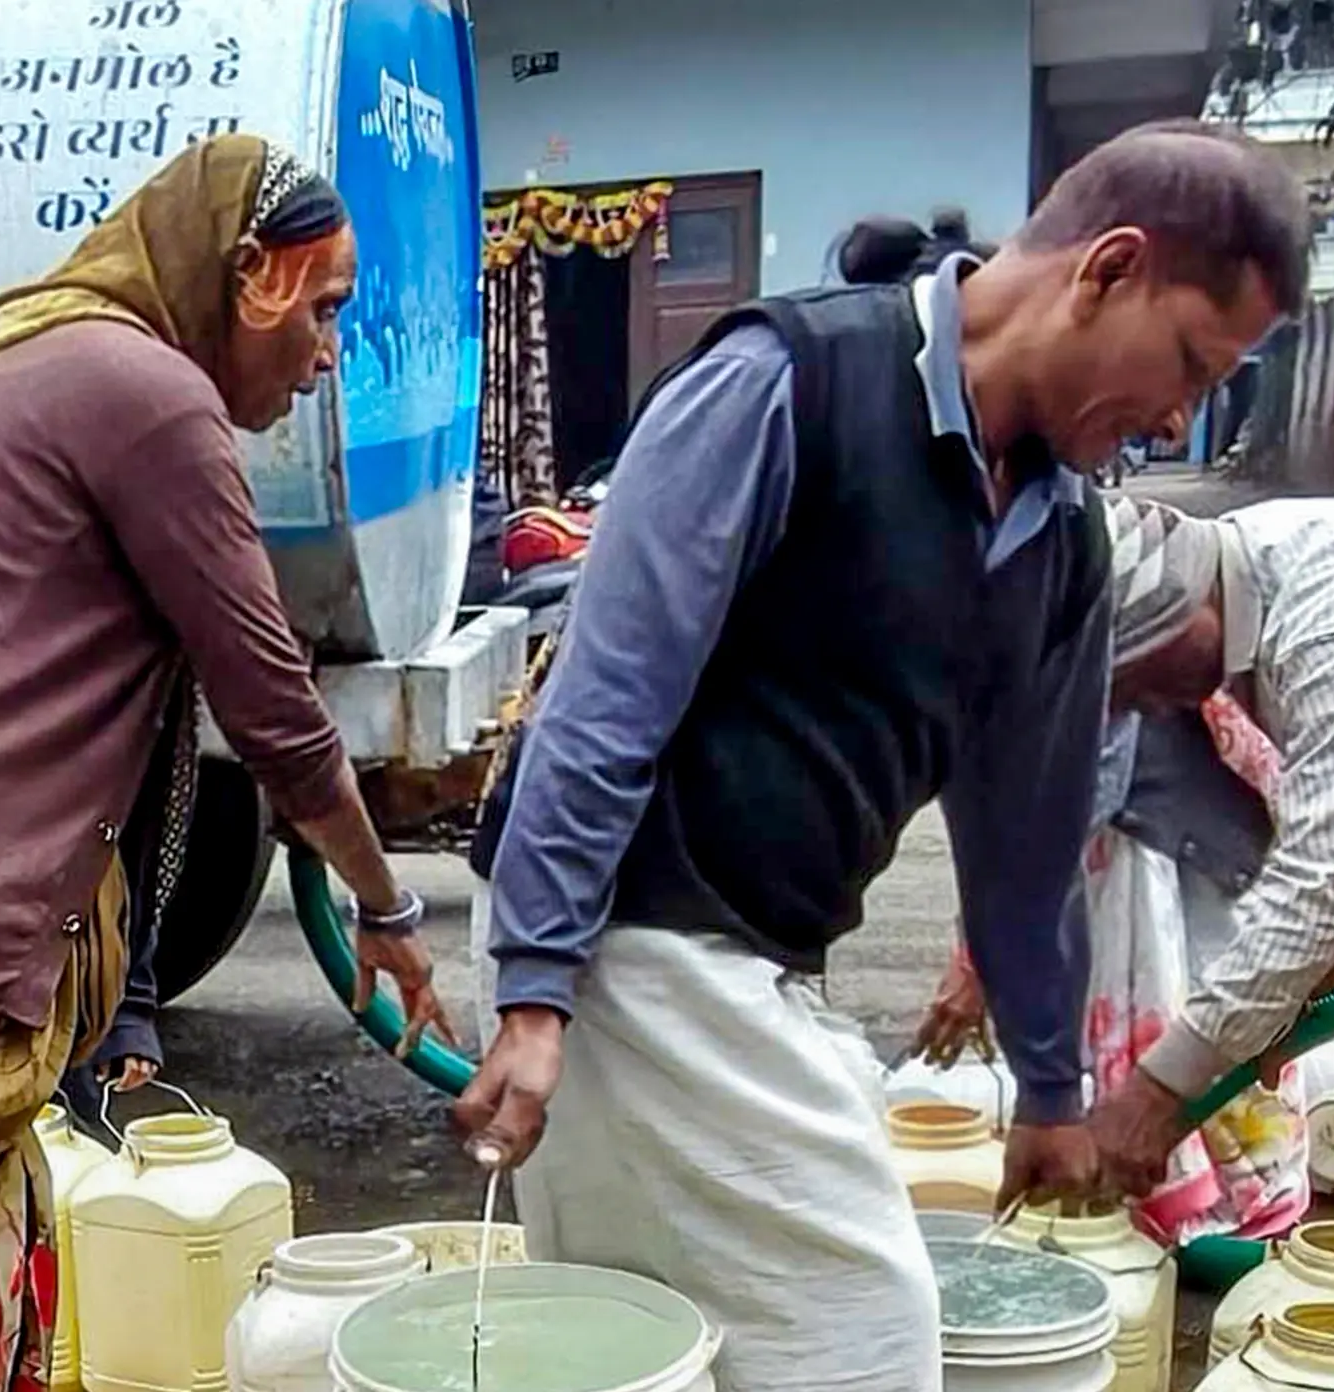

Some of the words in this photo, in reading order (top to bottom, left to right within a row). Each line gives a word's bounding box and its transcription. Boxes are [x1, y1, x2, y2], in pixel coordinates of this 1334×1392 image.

[0, 43, 193, 93] अनमोल
[209, 37, 241, 88] है
[68, 103, 174, 159] व्यर्थ
